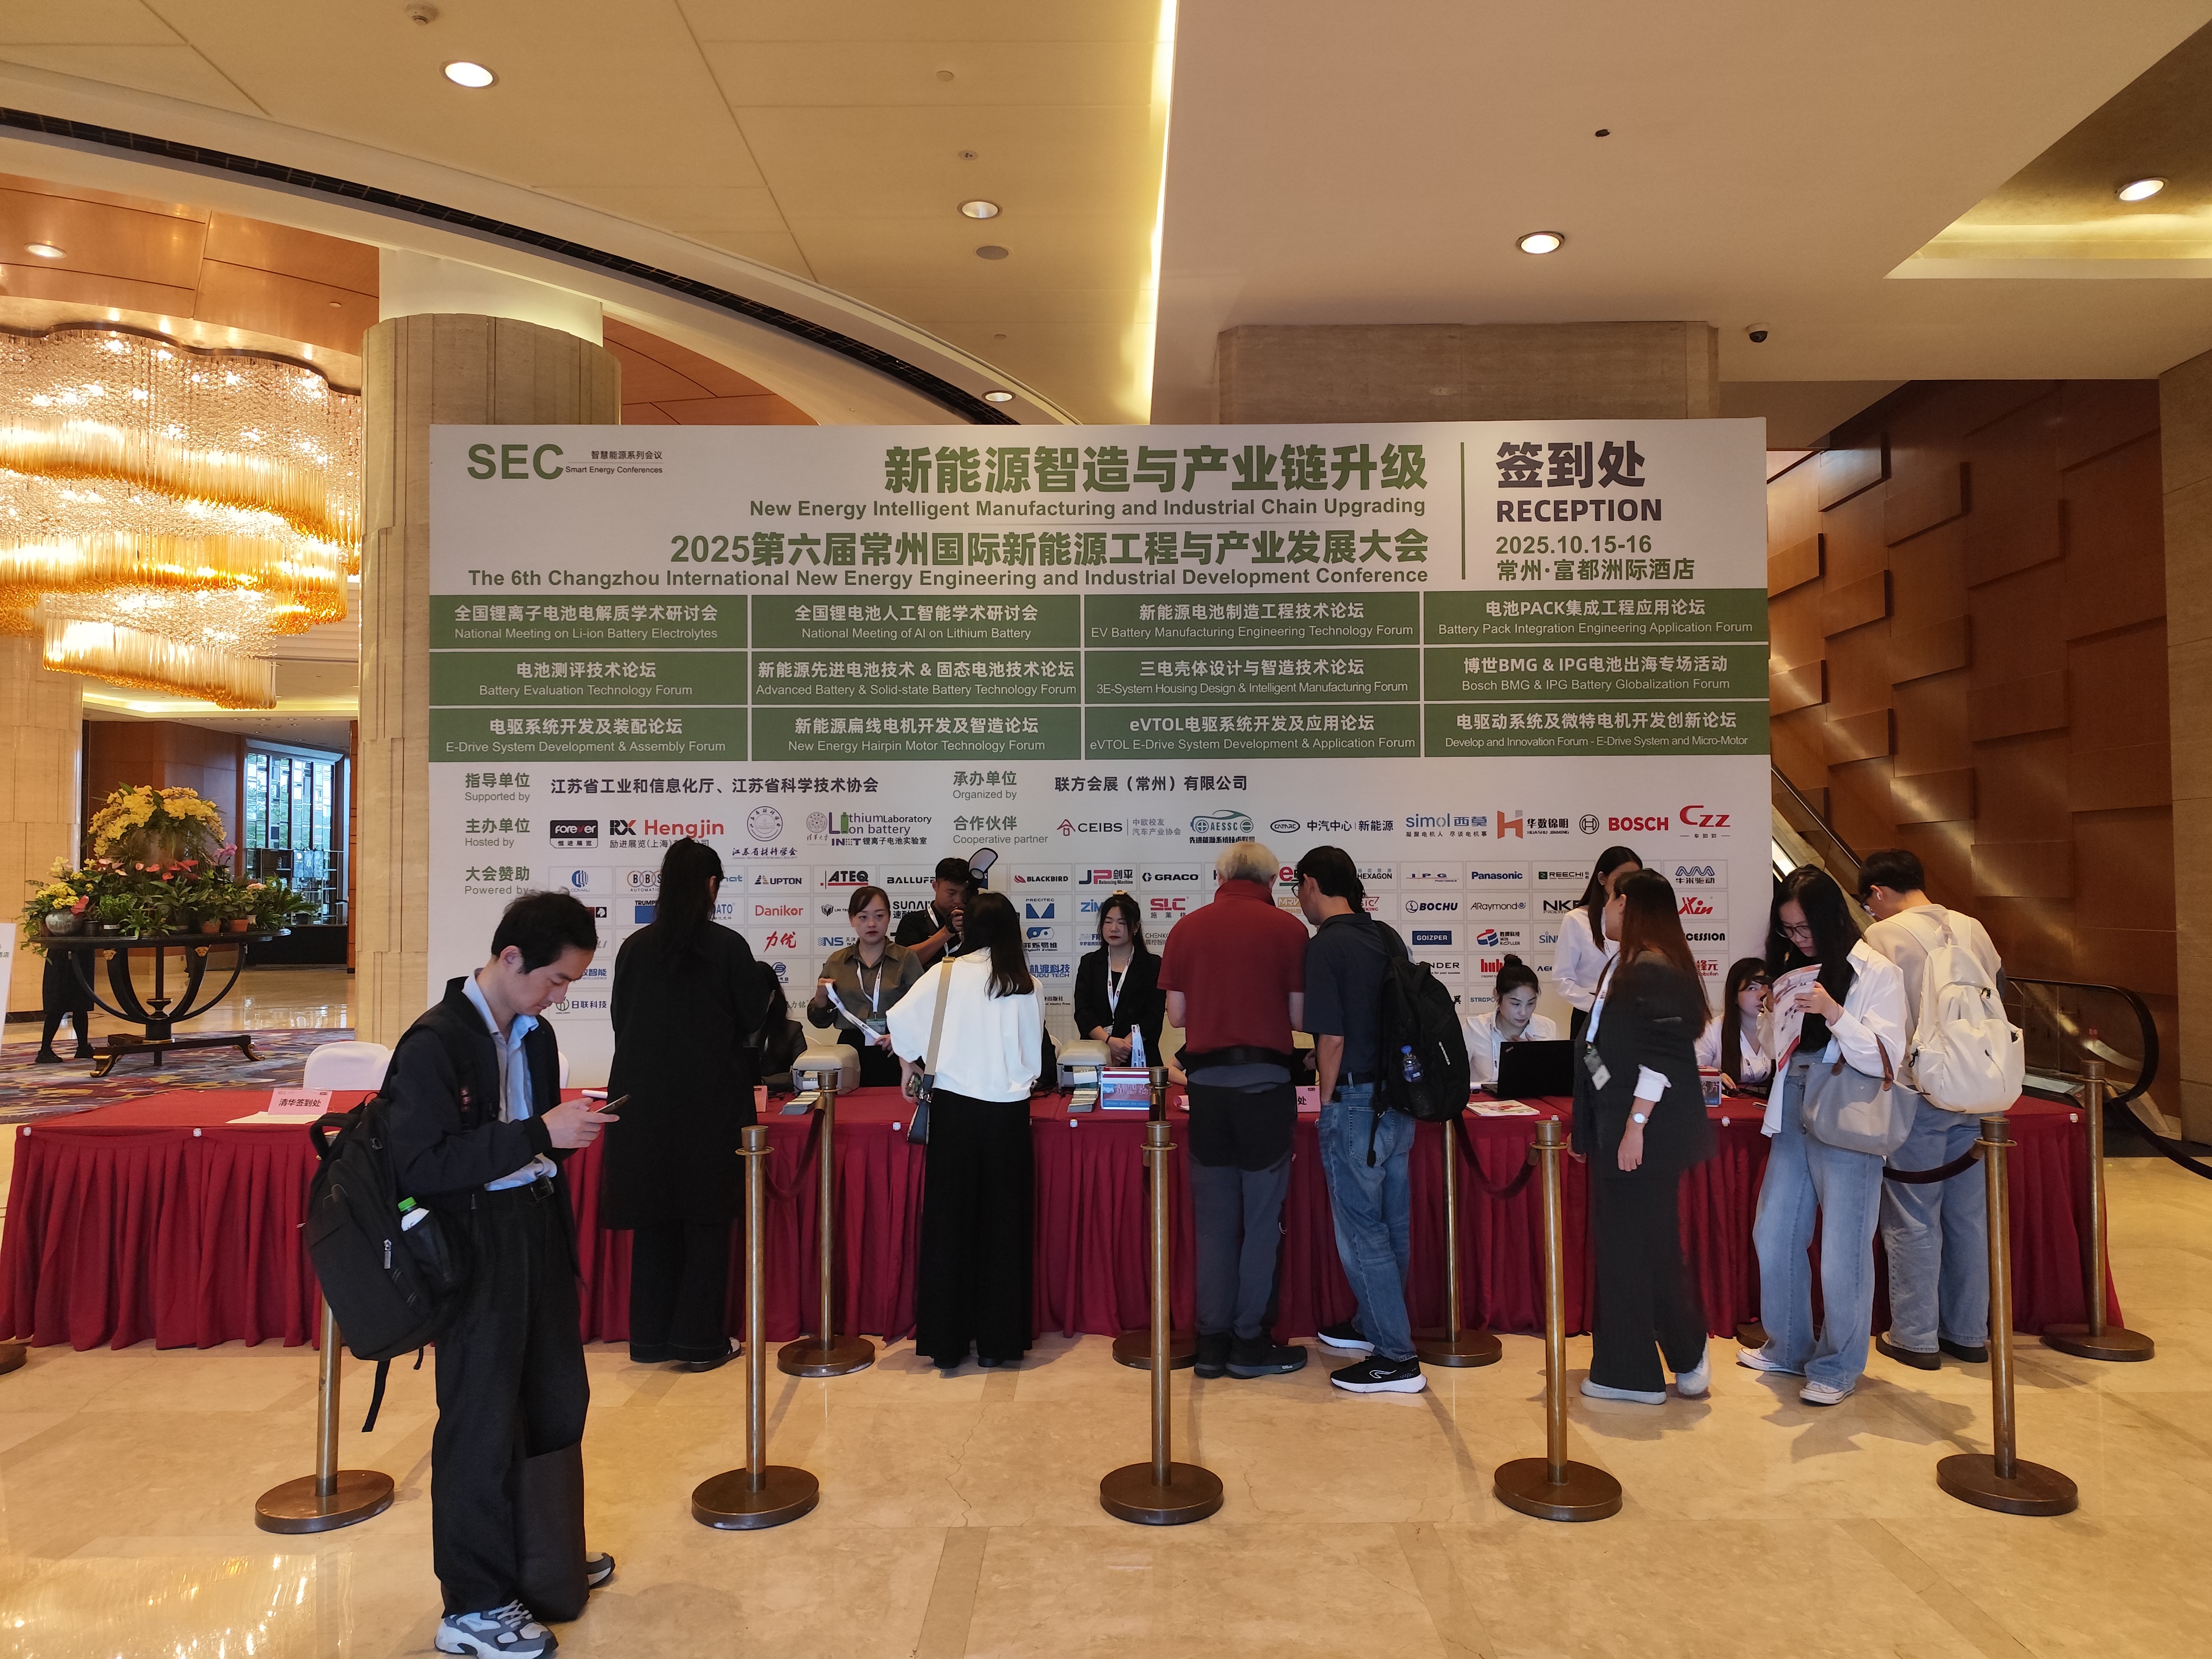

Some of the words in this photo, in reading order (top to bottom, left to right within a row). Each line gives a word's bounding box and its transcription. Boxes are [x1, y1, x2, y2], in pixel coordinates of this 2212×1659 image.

[467, 443, 564, 480] SEC
[591, 450, 663, 460] 智慧能源系列会议
[589, 466, 615, 475] Energy
[885, 443, 1427, 493] 新能源智造与产业链升级
[1496, 440, 1645, 488] 签到处
[750, 500, 792, 516] New
[798, 500, 867, 520] Energy
[873, 500, 969, 520] Intelligent
[976, 500, 1115, 519] Manufacturing
[1122, 499, 1157, 516] and
[1164, 499, 1255, 515] Industrial
[1261, 498, 1317, 515] Chain
[1324, 497, 1425, 517] Upgrading
[1497, 499, 1662, 523] RECEPTION
[671, 528, 1429, 567] 2025第六届常州国际新能源工程与产业发展大会
[1496, 535, 1652, 554] 2025.10.15-16
[1497, 557, 1695, 581] 常州·富都洲际酒店
[468, 570, 505, 586] The
[511, 570, 541, 586] 6th
[548, 570, 659, 590] Changzhou
[667, 570, 789, 586] International
[796, 570, 838, 586] New
[845, 570, 913, 590] Energy
[919, 570, 1036, 590] Engineering
[1043, 570, 1078, 586] and
[1085, 569, 1175, 585] Industrial
[1182, 569, 1310, 588] Development
[1316, 567, 1428, 583] Conference
[454, 604, 718, 622] 全国锂离子电池电解质学术研讨会
[795, 604, 1038, 622] 全国锂电池人工智能学术研讨会
[1139, 602, 1364, 621] 新能源电池制造工程技术论坛
[1486, 598, 1705, 617] 电池PACK集成工程应用论坛
[455, 628, 501, 639] National
[505, 628, 551, 641] Meeting
[554, 630, 569, 639] on
[573, 628, 604, 639] Li-ion
[607, 627, 648, 641] Battery
[652, 628, 718, 641] Electrolytes
[1091, 627, 1108, 638] EV
[1111, 627, 1152, 640] Battery
[1154, 626, 1234, 640] Manufacturing
[1238, 626, 1305, 639] Engineering
[1308, 625, 1373, 638] Technology
[1376, 624, 1413, 635] Forum
[1438, 624, 1480, 636] Battery
[1483, 623, 1511, 634] Pack
[1515, 623, 1574, 636] Integration
[1579, 622, 1647, 635] Engineering
[1649, 622, 1712, 635] Application
[1716, 621, 1753, 632] Forum
[517, 661, 656, 678] 电池测评技术论坛
[758, 661, 915, 678] 新能源先进电池技术
[920, 663, 932, 677] &
[937, 660, 1075, 678] 固态电池技术论坛
[1140, 658, 1364, 677] 三电壳体设计与智造技术论坛
[1463, 657, 1538, 674] 博世BMG
[1542, 658, 1554, 672] &
[1559, 655, 1727, 673] IPG电池出海专场活动
[479, 684, 520, 698] Battery
[524, 684, 584, 696] Evaluation
[587, 684, 652, 698] Technology
[655, 684, 692, 695] Forum
[755, 684, 812, 695] Advanced
[815, 684, 856, 698] Battery
[858, 684, 867, 695] &
[870, 684, 929, 695] Solid-state
[933, 684, 972, 698] Battery
[974, 684, 1038, 697] Technology
[1040, 683, 1076, 695] Forum
[490, 717, 683, 735] 电驱系统开发及装配论坛
[795, 716, 1039, 734] 新能源扁线电机开发及智造论坛
[1130, 714, 1374, 732] eVTOL电驱系统开发及应用论坛
[1457, 711, 1737, 730] 电驱动系统及微特电机开发创新论坛
[1090, 739, 1130, 750] eVTOL
[1133, 739, 1175, 750] E-Drive
[1178, 738, 1220, 752] System
[1223, 738, 1298, 751] Development
[1301, 738, 1310, 748] &
[1313, 737, 1375, 750] Application
[1378, 737, 1416, 748] Forum
[1445, 737, 1484, 749] Develop
[1486, 737, 1505, 747] and
[1507, 737, 1555, 747] Innovation
[1557, 736, 1589, 746] Forum
[1596, 736, 1632, 746] E-Drive
[1634, 735, 1670, 748] System
[1671, 736, 1689, 745] and
[1692, 735, 1748, 745] Micro-Motor
[465, 772, 530, 788] 指导单位
[953, 770, 1017, 787] 承办单位
[465, 792, 516, 803] Supported
[518, 792, 530, 803] by
[953, 789, 1002, 801] Organized
[1005, 789, 1017, 801] by
[465, 818, 530, 834] 主办单位
[884, 815, 932, 825] Laboratory
[953, 815, 1018, 831] 合作伙伴
[1077, 822, 1123, 833] CEIBS
[1133, 818, 1165, 826] 中欧校友
[1210, 822, 1238, 831] AESSC
[1307, 820, 1352, 832] 中汽中心
[1358, 820, 1393, 832] 新能源
[1454, 816, 1487, 827] 西莫
[1527, 818, 1568, 828] 华数锦明
[1608, 816, 1669, 831] BOSCH
[644, 819, 724, 839] Hengjin
[1132, 827, 1181, 836] 汽车产业协会
[465, 837, 500, 846] Hosted
[503, 837, 515, 848] by
[863, 837, 927, 845] 锂离子电池实验室
[953, 834, 1011, 846] Cooperative
[1014, 835, 1049, 845] partner
[465, 865, 530, 882] 大会赞助
[828, 870, 869, 882] ATEQ
[1471, 871, 1523, 880] Panasonic
[465, 885, 512, 895] Powered
[516, 885, 530, 895] by
[755, 904, 804, 916] Danikor
[1150, 898, 1186, 911] SLC
[1419, 902, 1458, 911] BOCHU
[1470, 902, 1518, 911] ARaymond
[764, 930, 796, 952] 力优
[571, 1000, 607, 1009] 日联科技
[279, 1098, 321, 1107] 清华签到处
